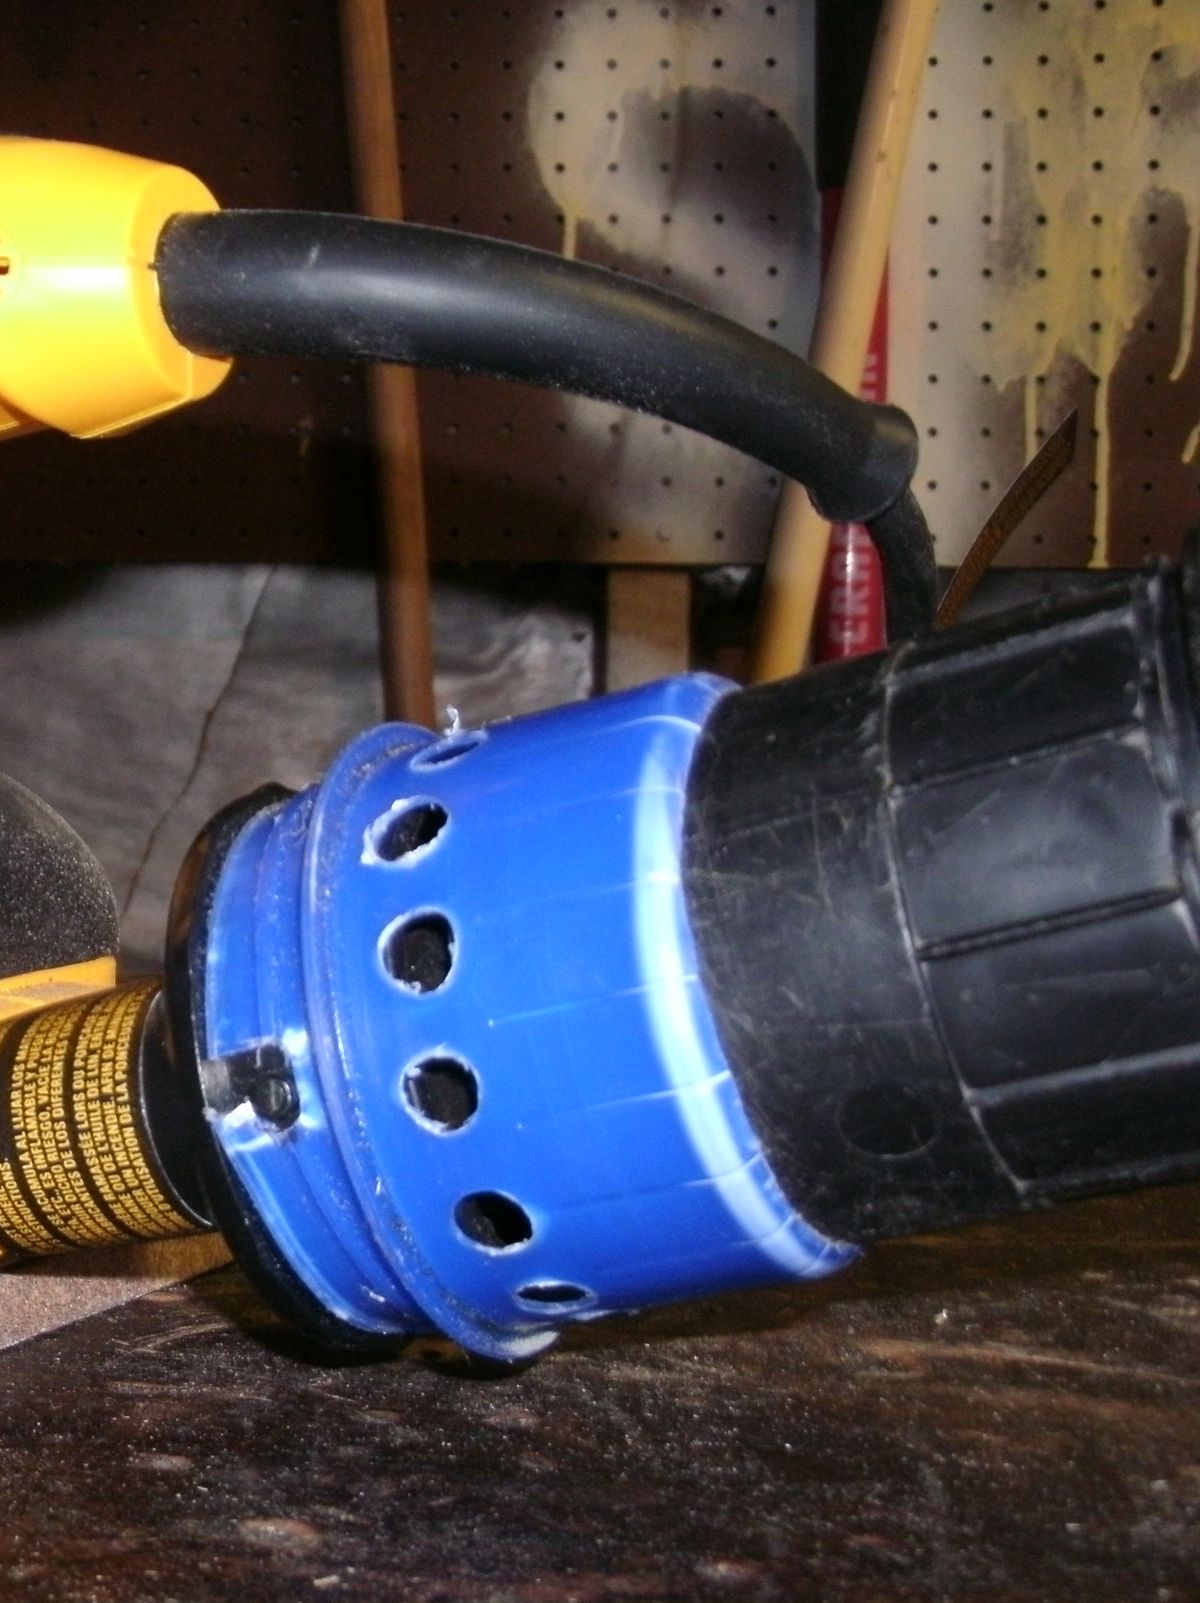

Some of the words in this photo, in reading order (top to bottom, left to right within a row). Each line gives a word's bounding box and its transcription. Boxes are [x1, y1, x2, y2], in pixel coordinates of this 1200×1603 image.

[89, 1014, 110, 1049] ENTRE
[40, 1045, 54, 1064] LA
[101, 1040, 115, 1060] DE
[115, 1012, 136, 1081] PONCEUSE
[11, 1062, 25, 1088] LOS
[25, 1069, 37, 1080] Y
[51, 1038, 68, 1119] DIFERENTES
[73, 1068, 84, 1090] DU
[86, 1077, 99, 1099] DE
[101, 1060, 112, 1094] AFIN
[115, 1081, 128, 1102] LA
[10, 1089, 24, 1129] LIJAR
[72, 1091, 89, 1129] LORS
[117, 1102, 132, 1124] DE
[24, 1081, 48, 1169] INFLAMABLE
[37, 1105, 61, 1162] RIESGO,
[53, 1120, 70, 1148] LOS
[86, 1098, 110, 1152] L'HUILE
[101, 1095, 131, 1167] INCENDIE.
[13, 1130, 28, 1149] AL
[59, 1149, 77, 1169] DE
[74, 1130, 119, 1202] RAMASSÉE
[98, 1152, 117, 1171] DE
[17, 1151, 55, 1213] ACUMULA
[38, 1171, 56, 1188] ES
[49, 1163, 79, 1202] DICHO
[107, 1173, 126, 1191] OU
[120, 1167, 141, 1187] UN
[66, 1170, 123, 1234] FABRICANTES
[45, 1213, 65, 1226] SE
